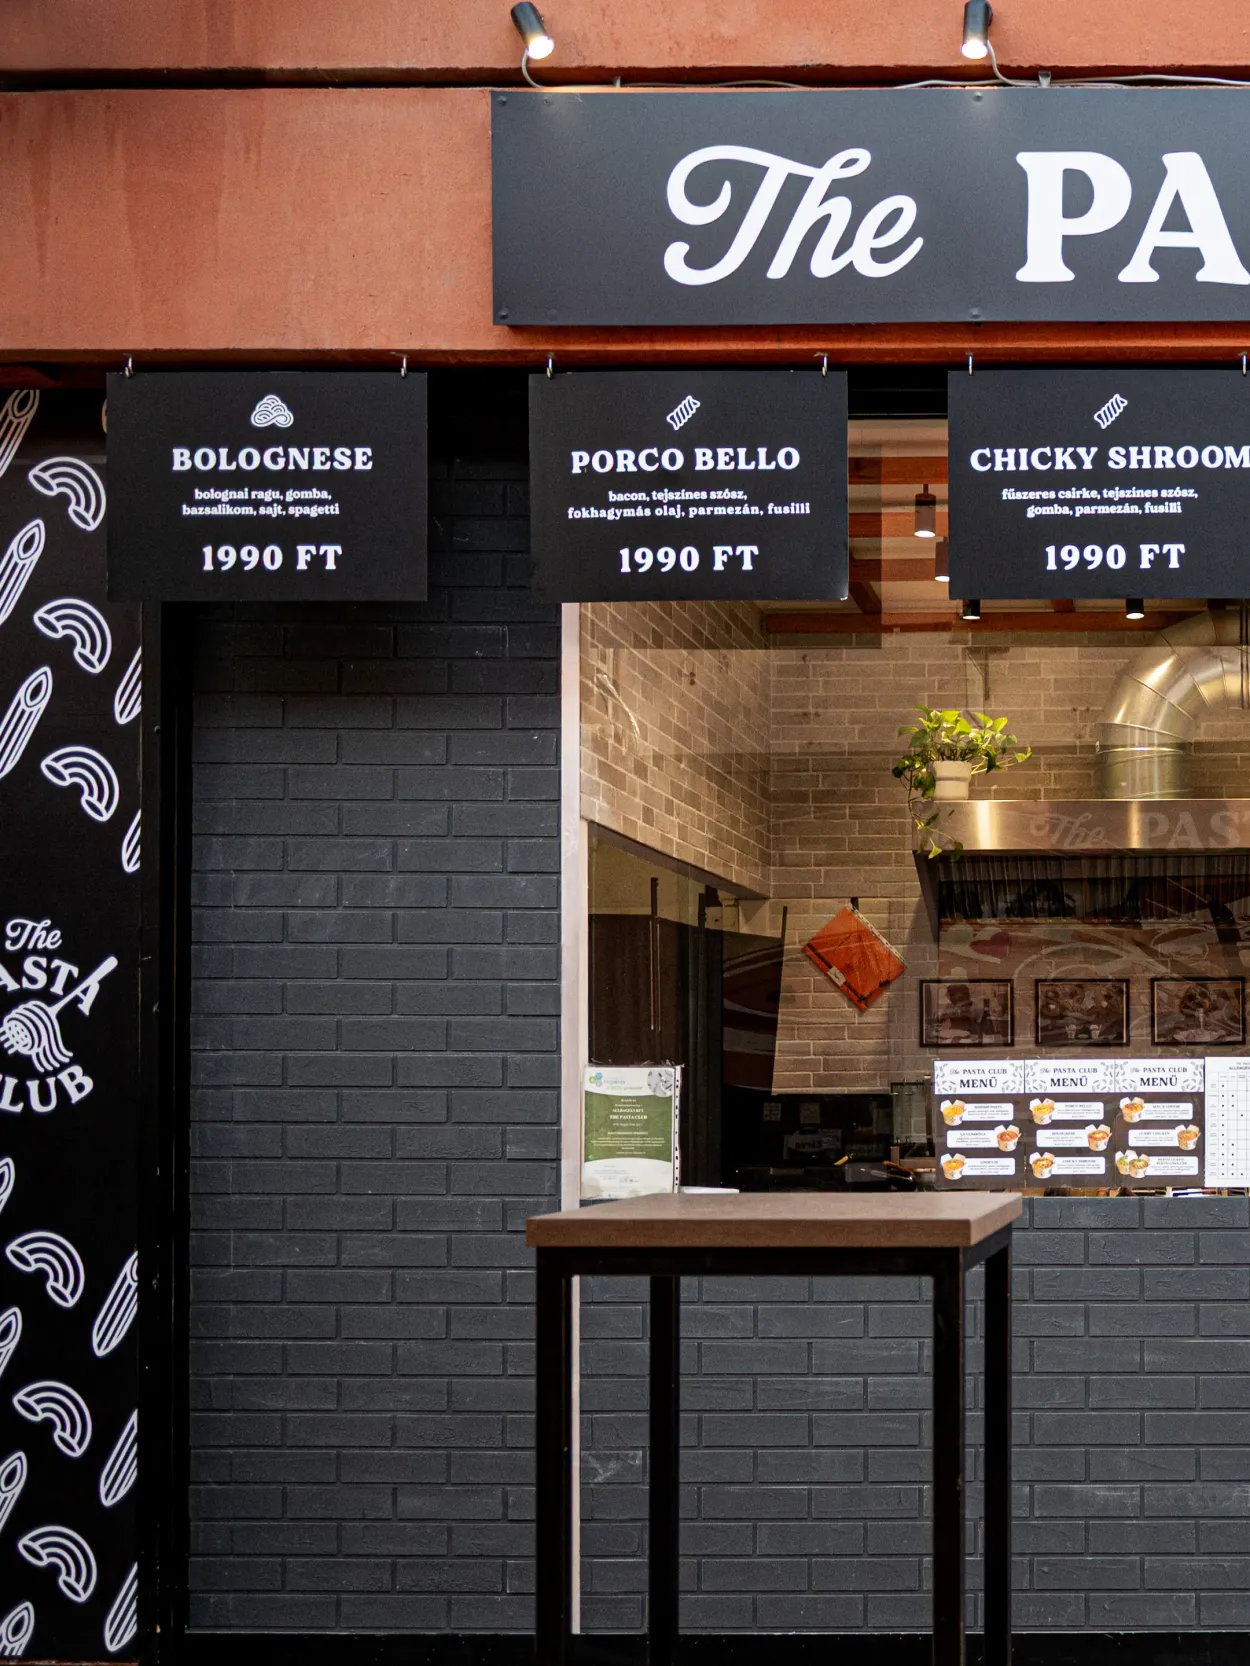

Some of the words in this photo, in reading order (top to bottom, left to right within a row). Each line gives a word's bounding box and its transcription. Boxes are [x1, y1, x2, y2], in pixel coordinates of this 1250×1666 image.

[664, 145, 923, 285] The
[172, 446, 373, 471] BOLOGNESE
[571, 448, 684, 474] PORCO
[694, 447, 800, 471] BELLO
[970, 447, 1099, 472] CHICKY
[194, 488, 248, 502] bolognai
[251, 491, 283, 502] ragu,
[285, 488, 332, 502] gomba,
[608, 491, 650, 502] bacon,
[651, 489, 707, 503] tejszínes
[710, 488, 748, 501] szósz,
[1001, 488, 1056, 500] fűszeres
[1058, 488, 1101, 500] csirke,
[1102, 486, 1158, 501] tejszínes
[1161, 486, 1198, 499] szósz,
[182, 504, 257, 516] bazsalikom,
[259, 504, 286, 518] sajt,
[288, 504, 340, 518] spagetti
[568, 505, 651, 520] fokhagymás
[655, 505, 685, 518] olaj,
[689, 504, 764, 518] parmezán,
[767, 502, 811, 515] fusilli
[1026, 504, 1073, 518] gomba,
[1075, 502, 1143, 517] parmezán,
[1144, 501, 1182, 514] fusilli
[202, 545, 283, 571] 1990
[296, 545, 342, 570] FT
[619, 546, 700, 573] 1990
[712, 545, 759, 571] FT
[1045, 544, 1126, 570] 1990
[1139, 543, 1186, 569] FT
[5, 918, 62, 951] The
[0, 955, 101, 1017] ASTA
[0, 1065, 94, 1113] LUB
[959, 1076, 998, 1088] MENÜ
[1050, 1075, 1089, 1088] MENÜ
[1139, 1074, 1178, 1087] MENÜ
